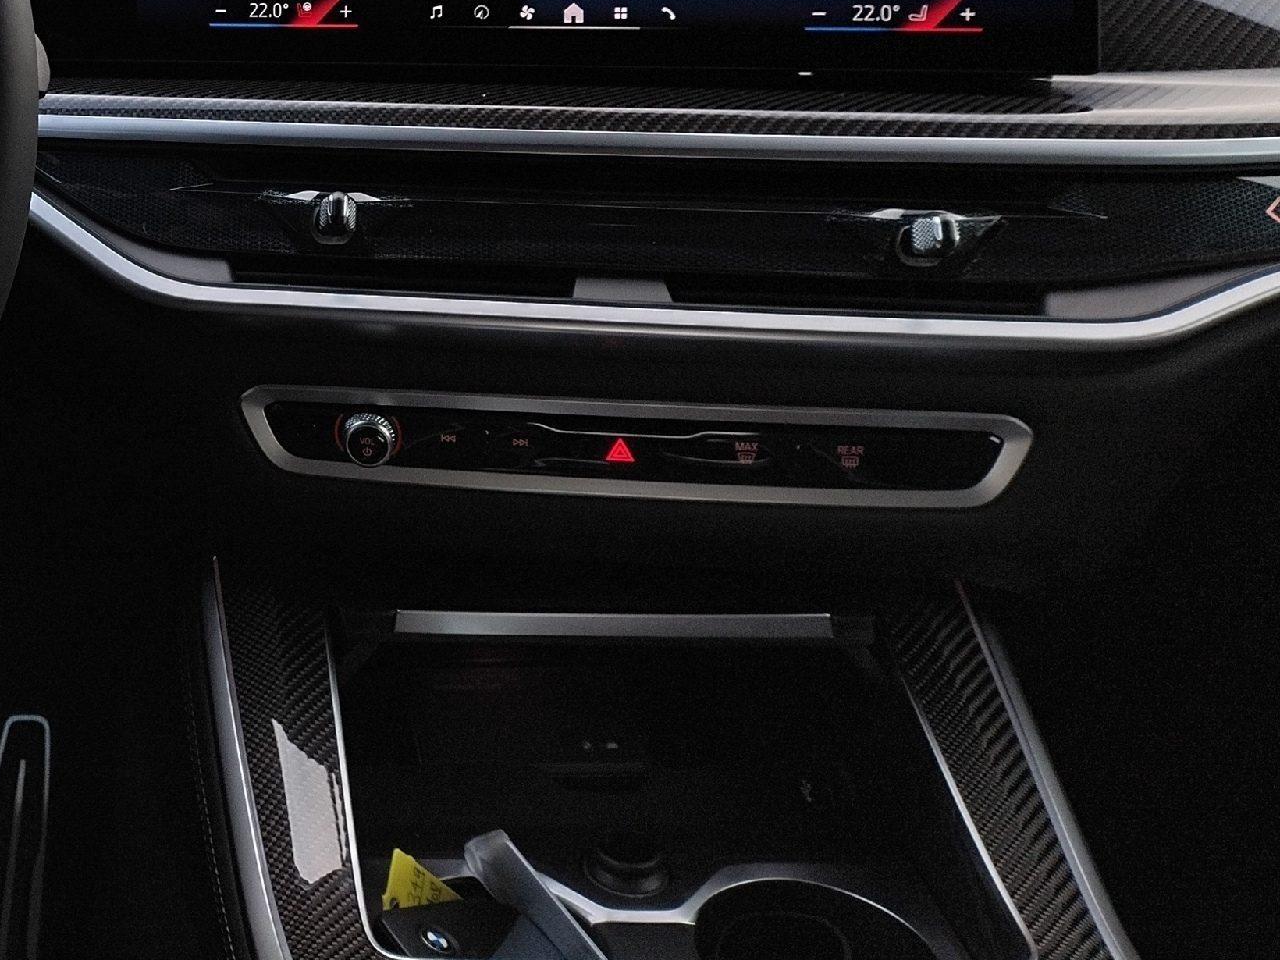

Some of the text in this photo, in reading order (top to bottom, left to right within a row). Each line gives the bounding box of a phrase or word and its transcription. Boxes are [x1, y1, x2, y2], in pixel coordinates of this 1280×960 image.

[249, 2, 289, 18] 22.0°
[852, 4, 901, 22] 22.0°
[735, 442, 759, 452] MAX
[837, 445, 864, 455] REAR
